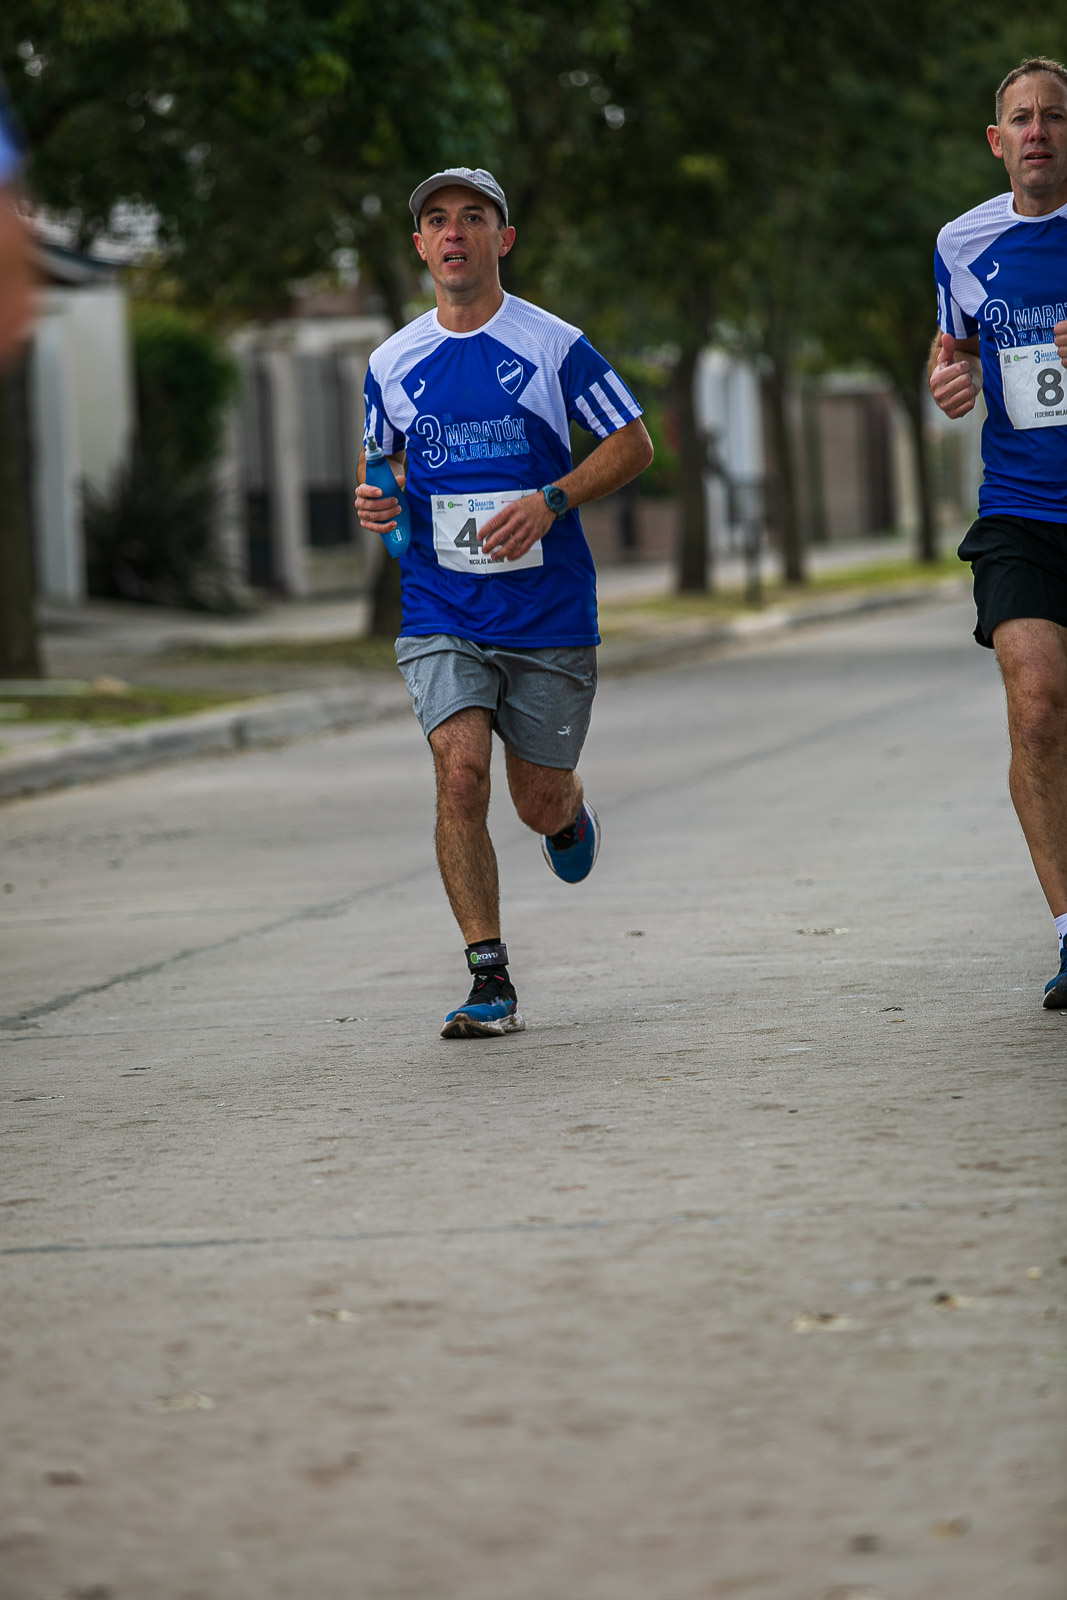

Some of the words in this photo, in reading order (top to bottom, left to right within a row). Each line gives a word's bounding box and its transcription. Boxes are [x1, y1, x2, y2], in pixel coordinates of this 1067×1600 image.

[984, 299, 1017, 350] 3
[1014, 302, 1067, 332] MARA
[1034, 350, 1041, 364] 3
[1037, 368, 1065, 407] 8
[1034, 410, 1055, 419] FEDERICO
[416, 414, 448, 468] 3
[444, 415, 527, 446] MARATÓN
[468, 499, 475, 512] 3
[469, 557, 487, 565] NICOLÁS
